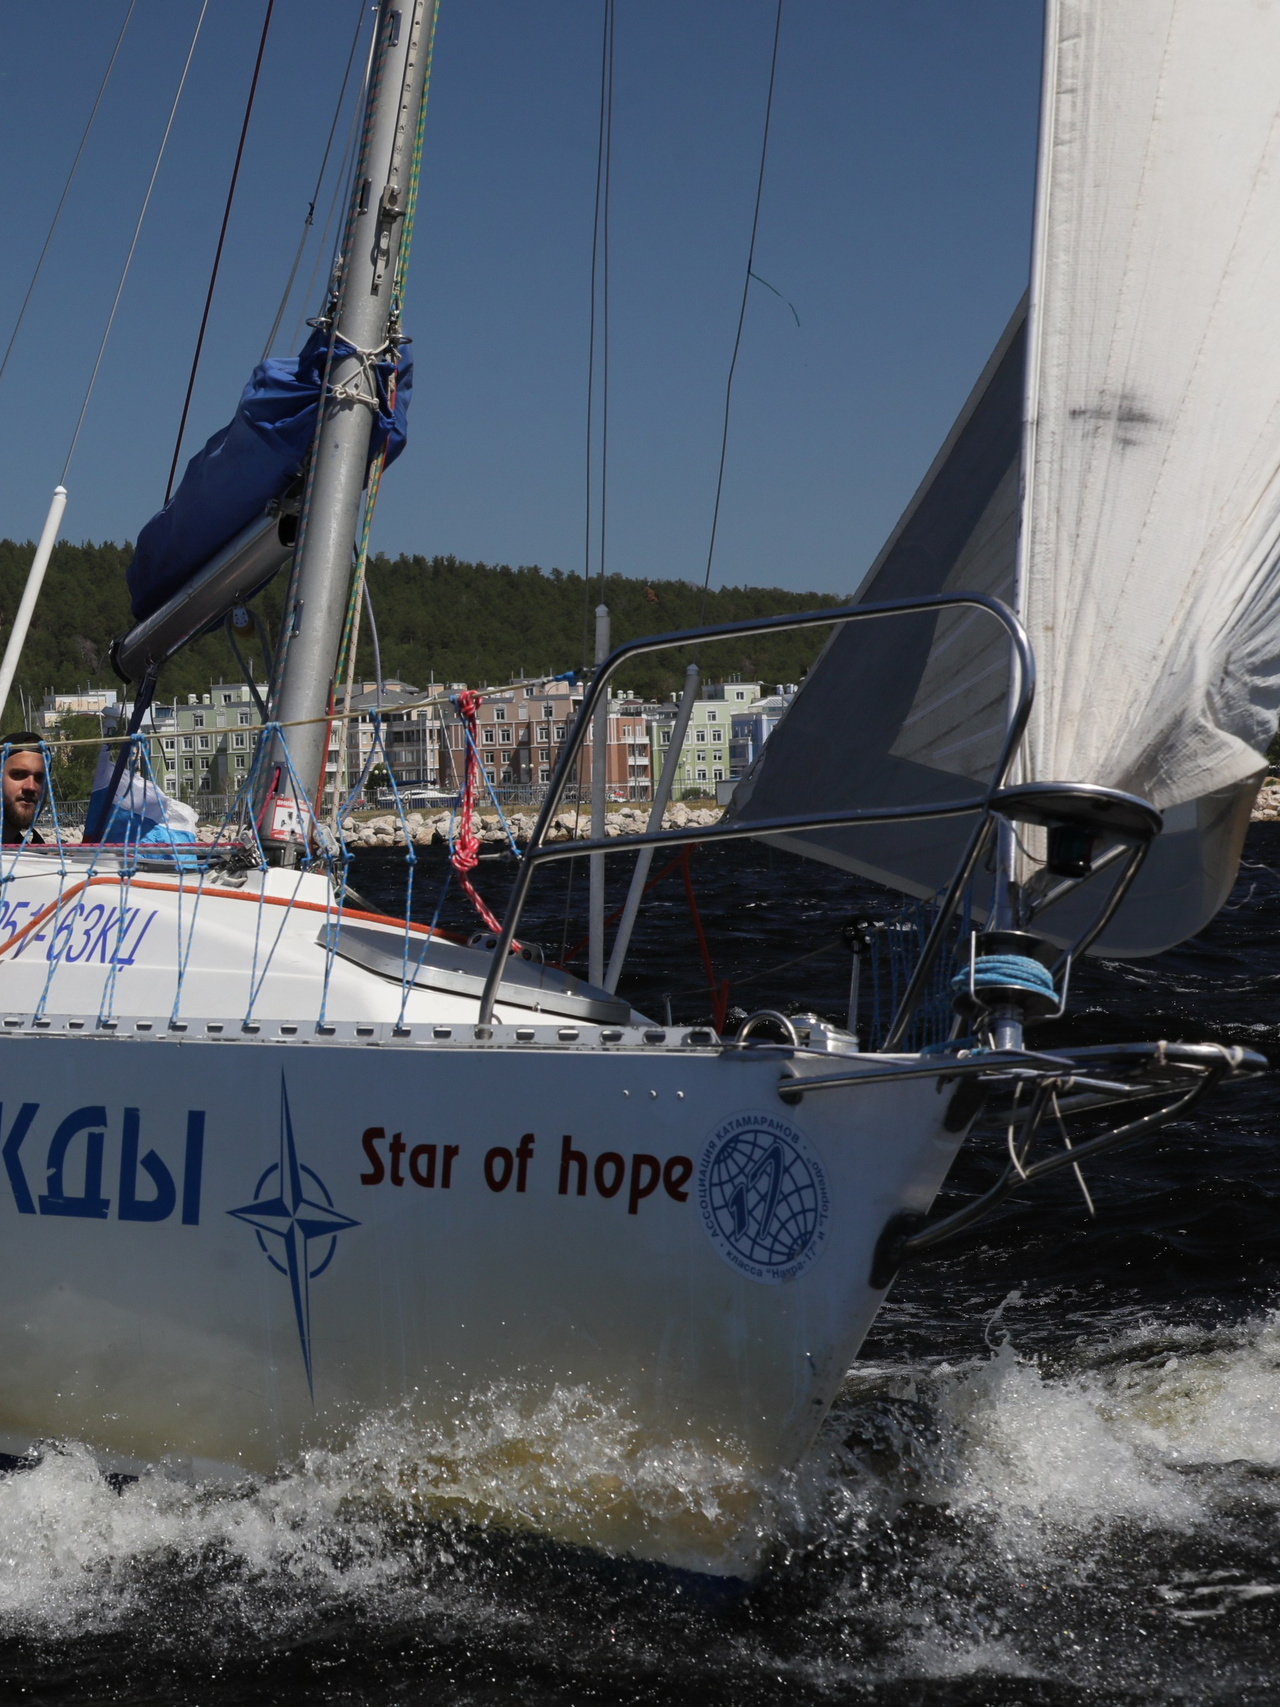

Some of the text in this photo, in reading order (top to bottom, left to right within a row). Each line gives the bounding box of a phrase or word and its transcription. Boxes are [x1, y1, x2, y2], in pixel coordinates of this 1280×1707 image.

[360, 1127, 694, 1215] Star of hope
[698, 1115, 800, 1239] АССОЦИАЦИЯ КАТАМАРАНОВ
[726, 1250, 763, 1277] класса
